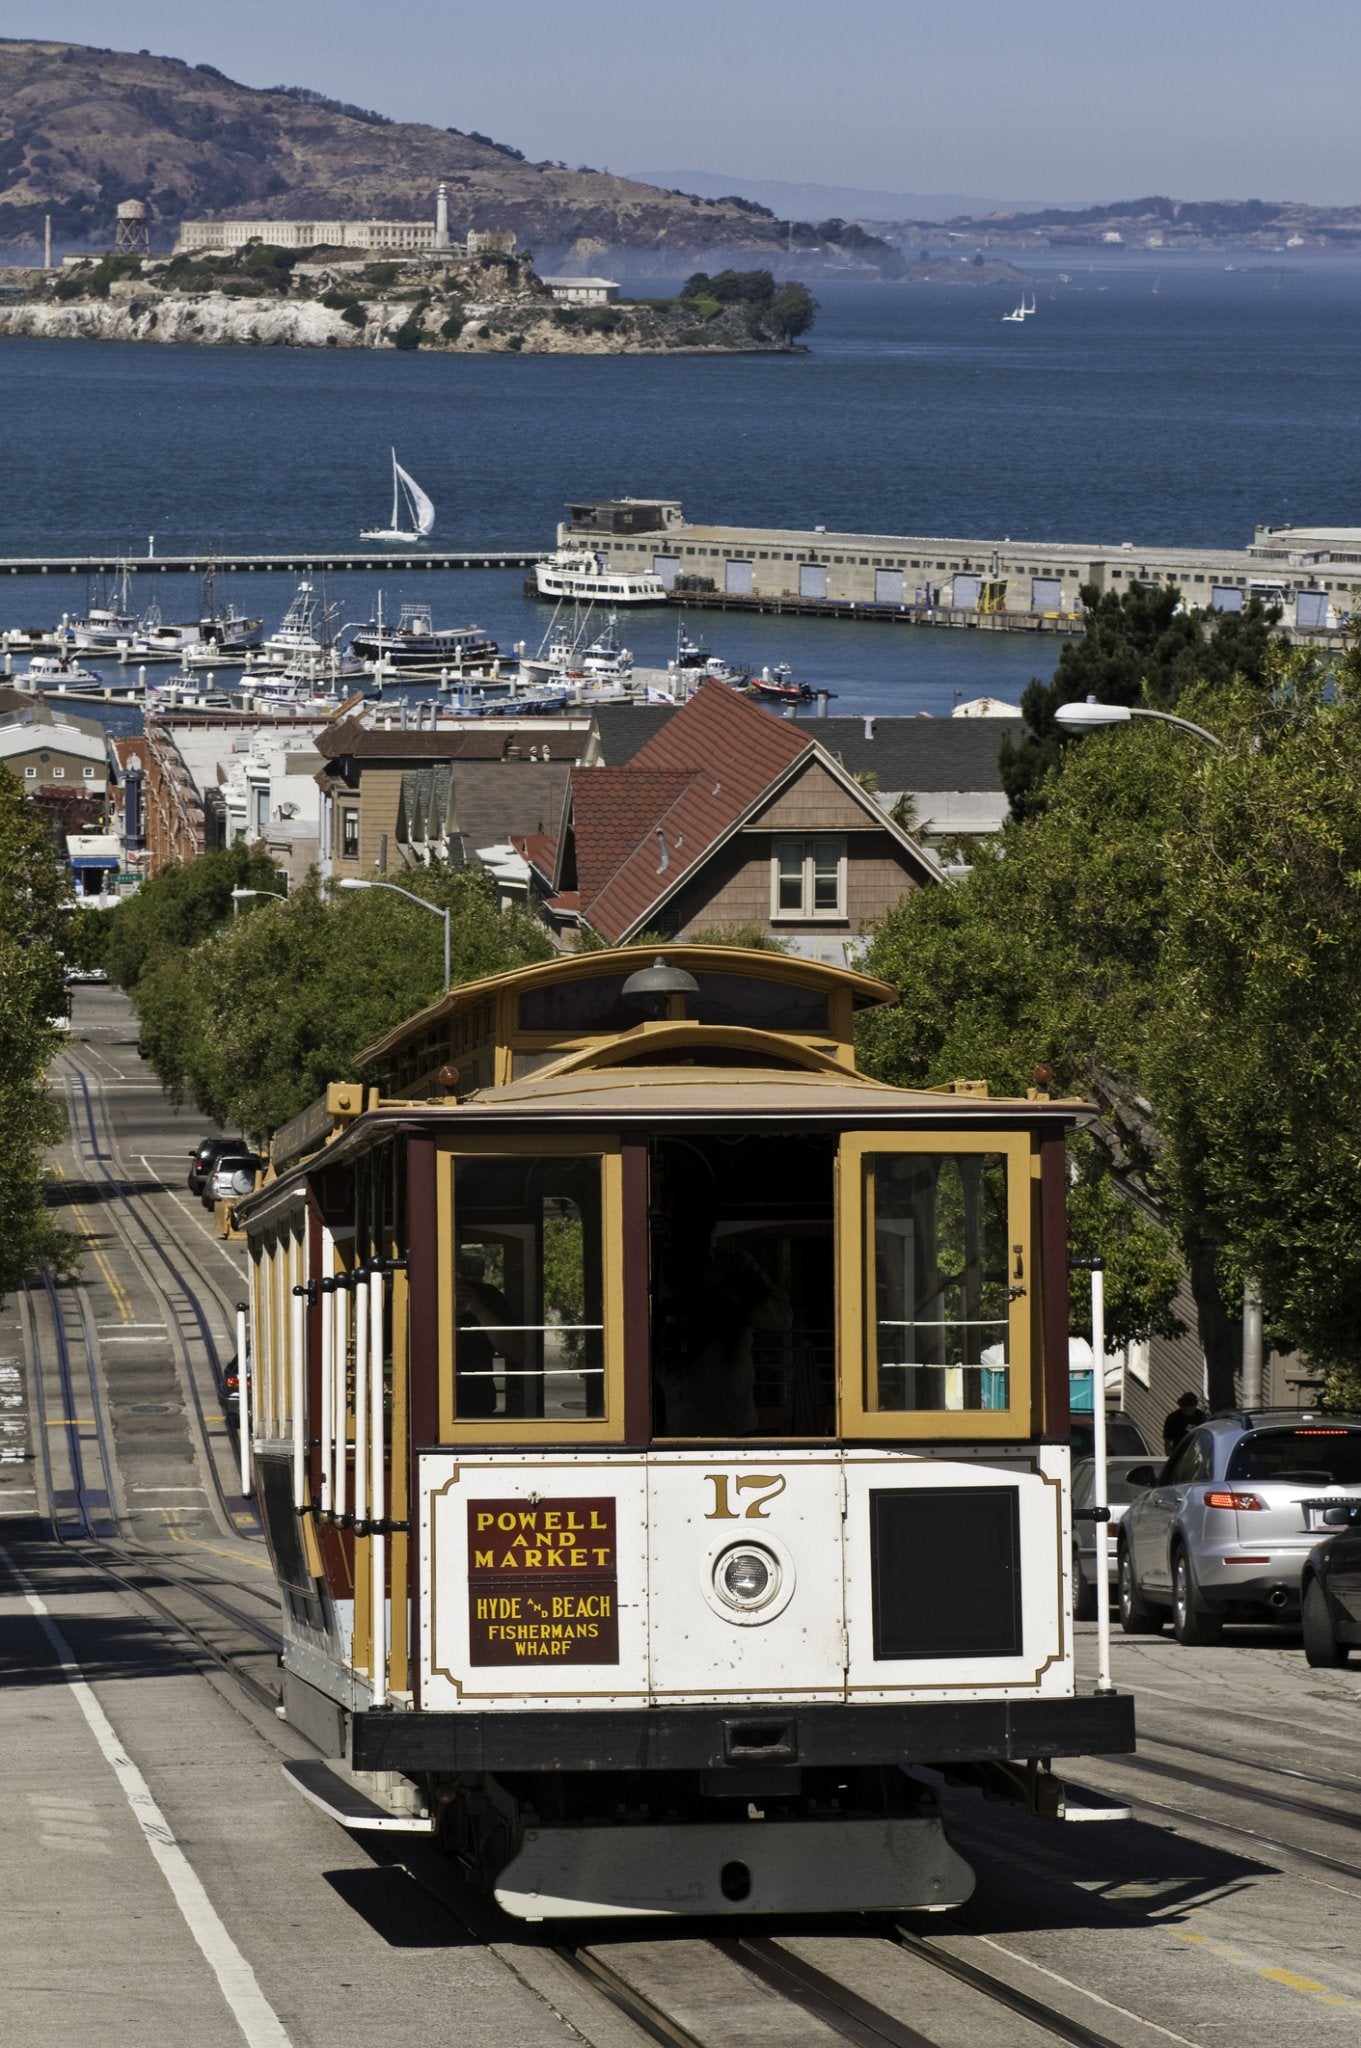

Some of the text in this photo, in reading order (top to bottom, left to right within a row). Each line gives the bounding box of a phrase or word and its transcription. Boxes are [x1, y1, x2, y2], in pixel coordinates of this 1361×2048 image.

[704, 1474, 787, 1519] 17
[478, 1511, 606, 1530] POWELL
[512, 1532, 575, 1547] AND
[476, 1549, 610, 1568] MARKET
[478, 1596, 610, 1619] HYDE AND BEACH
[489, 1624, 598, 1639] FISHERMANS
[515, 1641, 571, 1655] WHARF
